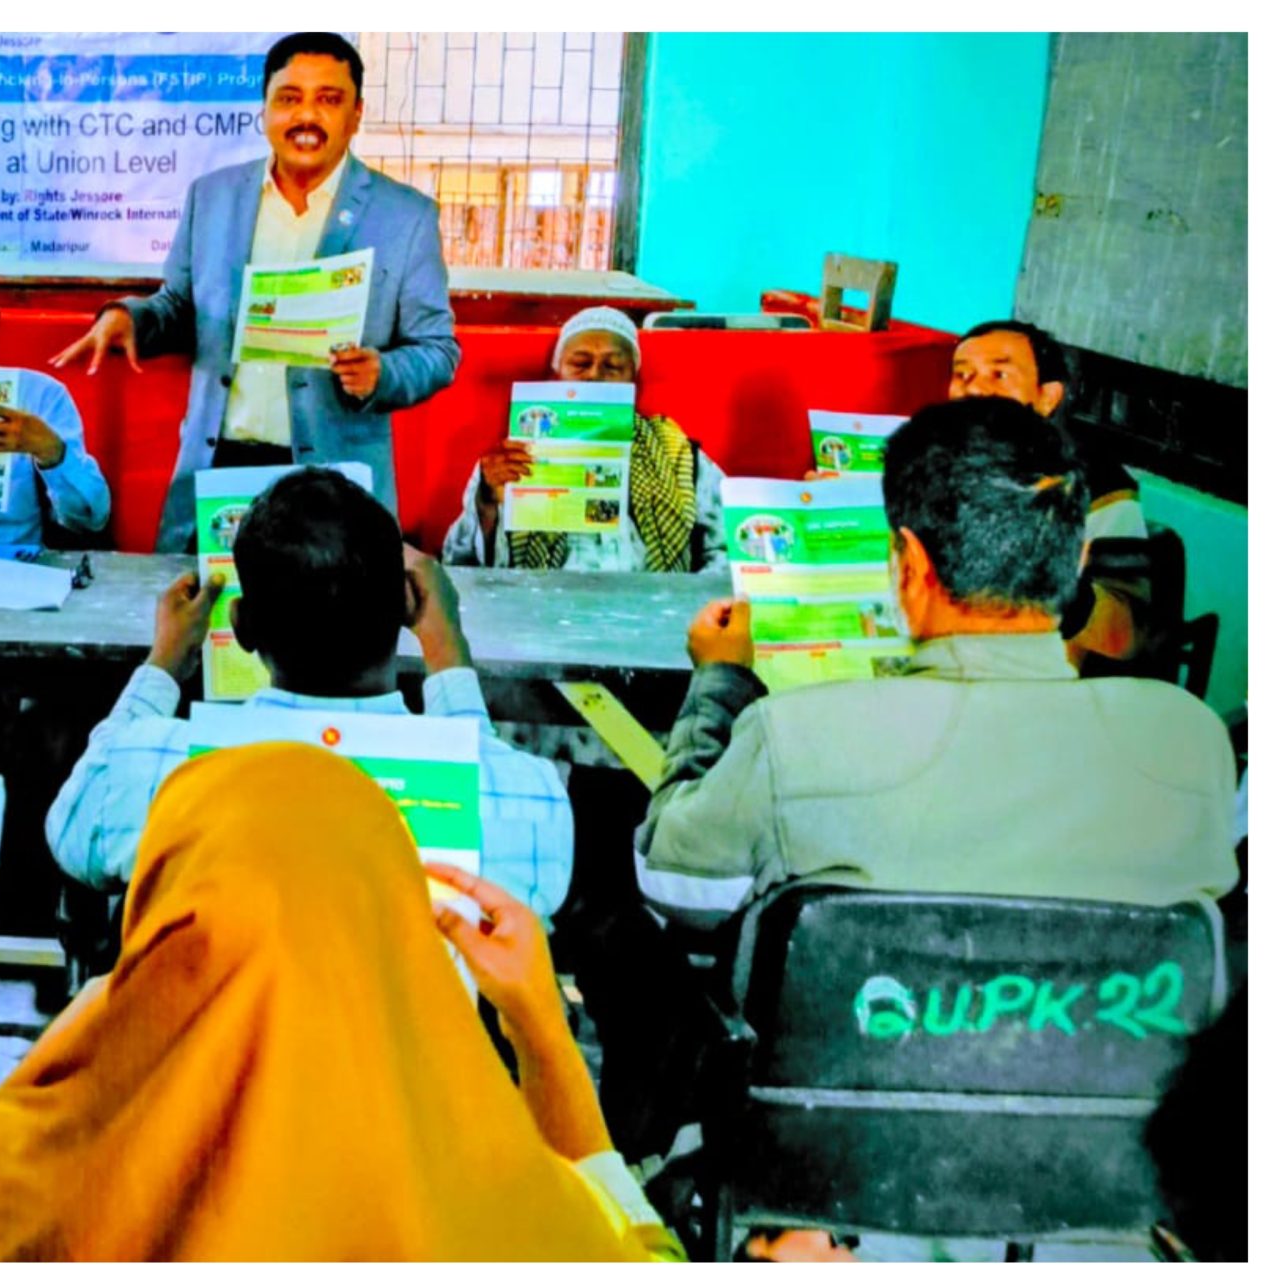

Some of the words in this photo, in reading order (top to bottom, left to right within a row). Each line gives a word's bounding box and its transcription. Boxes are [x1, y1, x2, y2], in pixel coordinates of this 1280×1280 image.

[218, 72, 264, 91] Progr
[23, 113, 69, 137] with
[78, 113, 134, 137] CTC
[142, 113, 187, 137] and
[6, 151, 28, 174] at
[37, 150, 106, 174] Union
[114, 150, 177, 174] Level
[24, 189, 66, 206] Rights
[70, 190, 124, 203] Jessore
[17, 208, 30, 221] of
[126, 207, 181, 220] Internati
[30, 240, 91, 254] Madaripur
